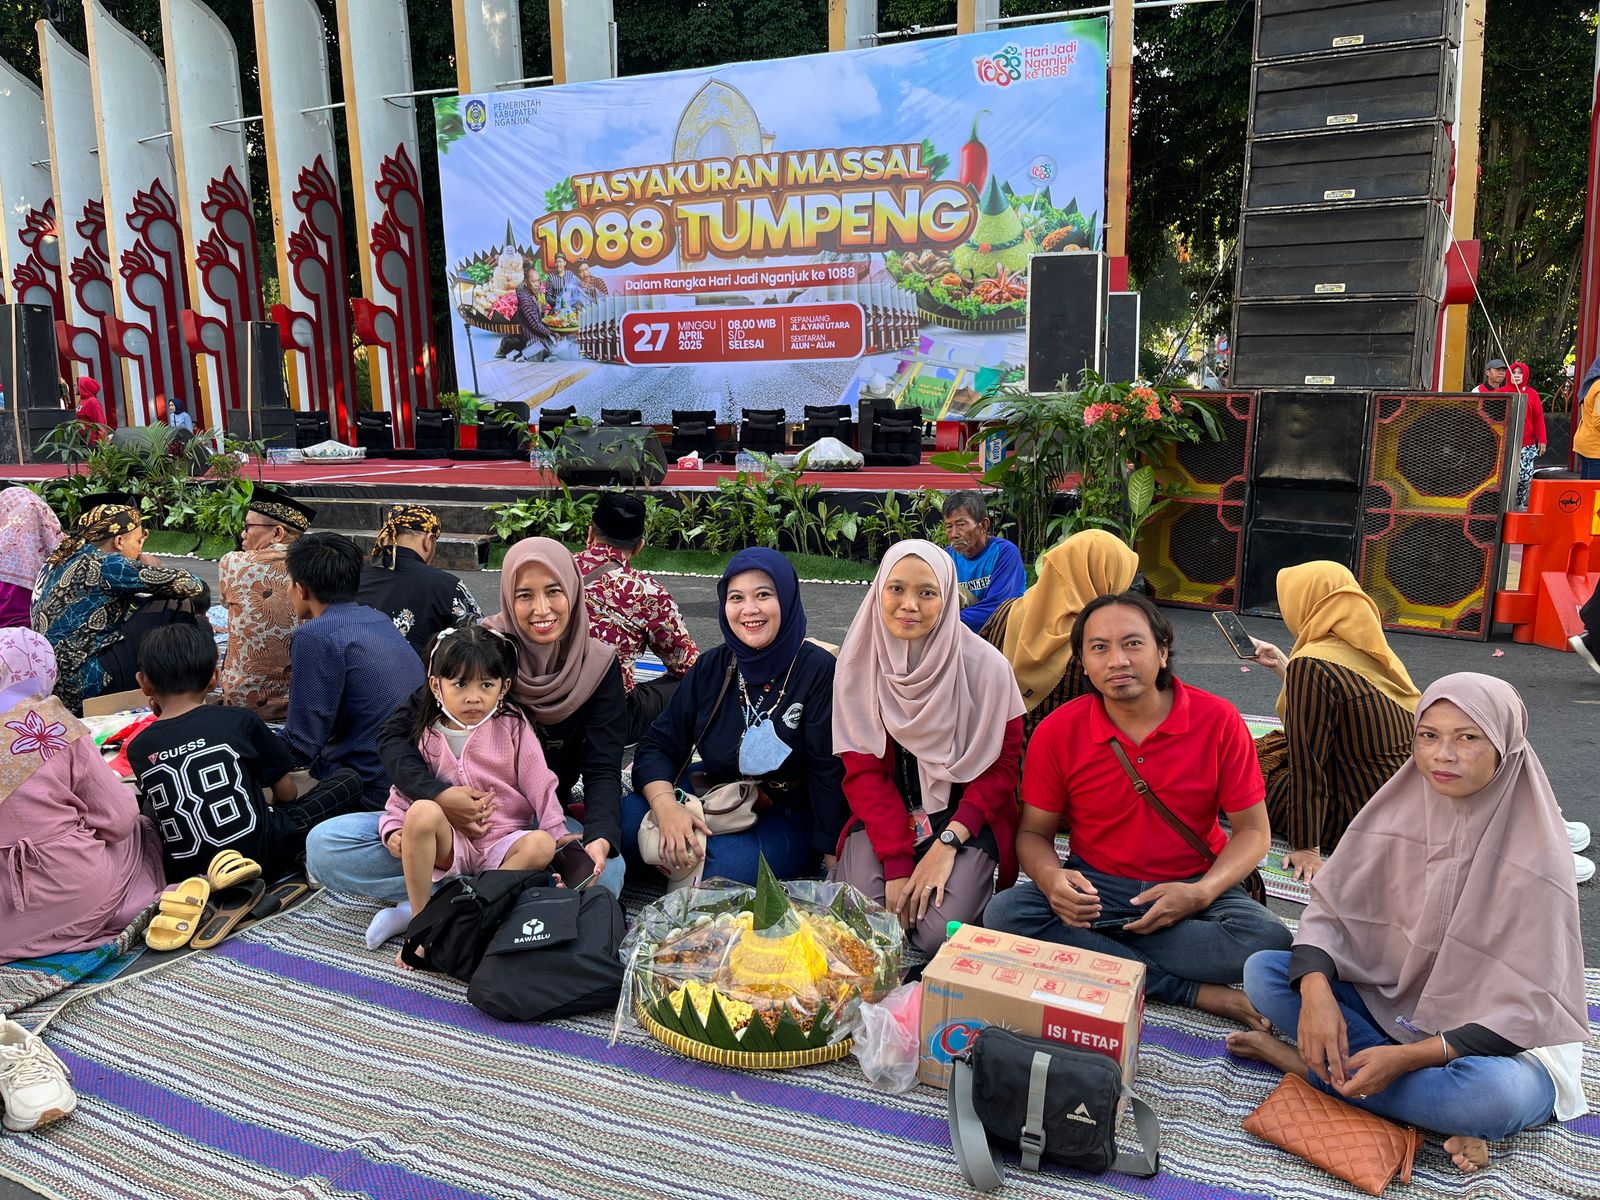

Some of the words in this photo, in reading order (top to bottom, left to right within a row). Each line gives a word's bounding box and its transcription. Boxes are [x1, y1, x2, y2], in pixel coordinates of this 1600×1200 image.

[1025, 45, 1049, 58] Hari
[1051, 41, 1077, 55] Jadi
[1025, 54, 1074, 71] Nganjuk
[1025, 69, 1038, 80] ke
[1041, 65, 1067, 77] 1088
[494, 99, 541, 111] PEMERINTAH
[494, 108, 538, 119] KABUPATEN
[494, 116, 531, 127] NGANJUK
[574, 153, 780, 206] TASYAKURAN
[786, 145, 928, 184] MASSAL
[538, 206, 664, 267] 1088
[677, 185, 971, 258] TUMPENG
[625, 279, 662, 291] Dalam
[664, 276, 706, 291] Rangka
[708, 274, 732, 287] Hari
[733, 273, 758, 285] Jadi
[760, 270, 810, 286] Nganjuk
[811, 269, 826, 281] ke
[827, 267, 856, 280] 1088
[678, 320, 716, 331] MINGGU
[728, 319, 755, 330] 08.00
[756, 318, 776, 329] WIB
[790, 315, 830, 324] SEPANJANG
[825, 322, 850, 330] UTARA
[633, 323, 670, 352] 27
[678, 330, 704, 341] APRIL
[728, 330, 745, 341] S/D
[790, 334, 826, 343] SEKITARAN
[678, 340, 702, 350] 2025
[728, 340, 764, 350] SELESAI
[791, 341, 810, 350] ALUN
[816, 340, 835, 349] ALUN
[158, 738, 206, 761] GUESS
[141, 743, 257, 860] 88
[514, 933, 551, 944] BAWASLU
[1048, 1023, 1067, 1040] ISI
[1071, 1028, 1119, 1051] TETAP
[1066, 1113, 1097, 1126] EIGER
